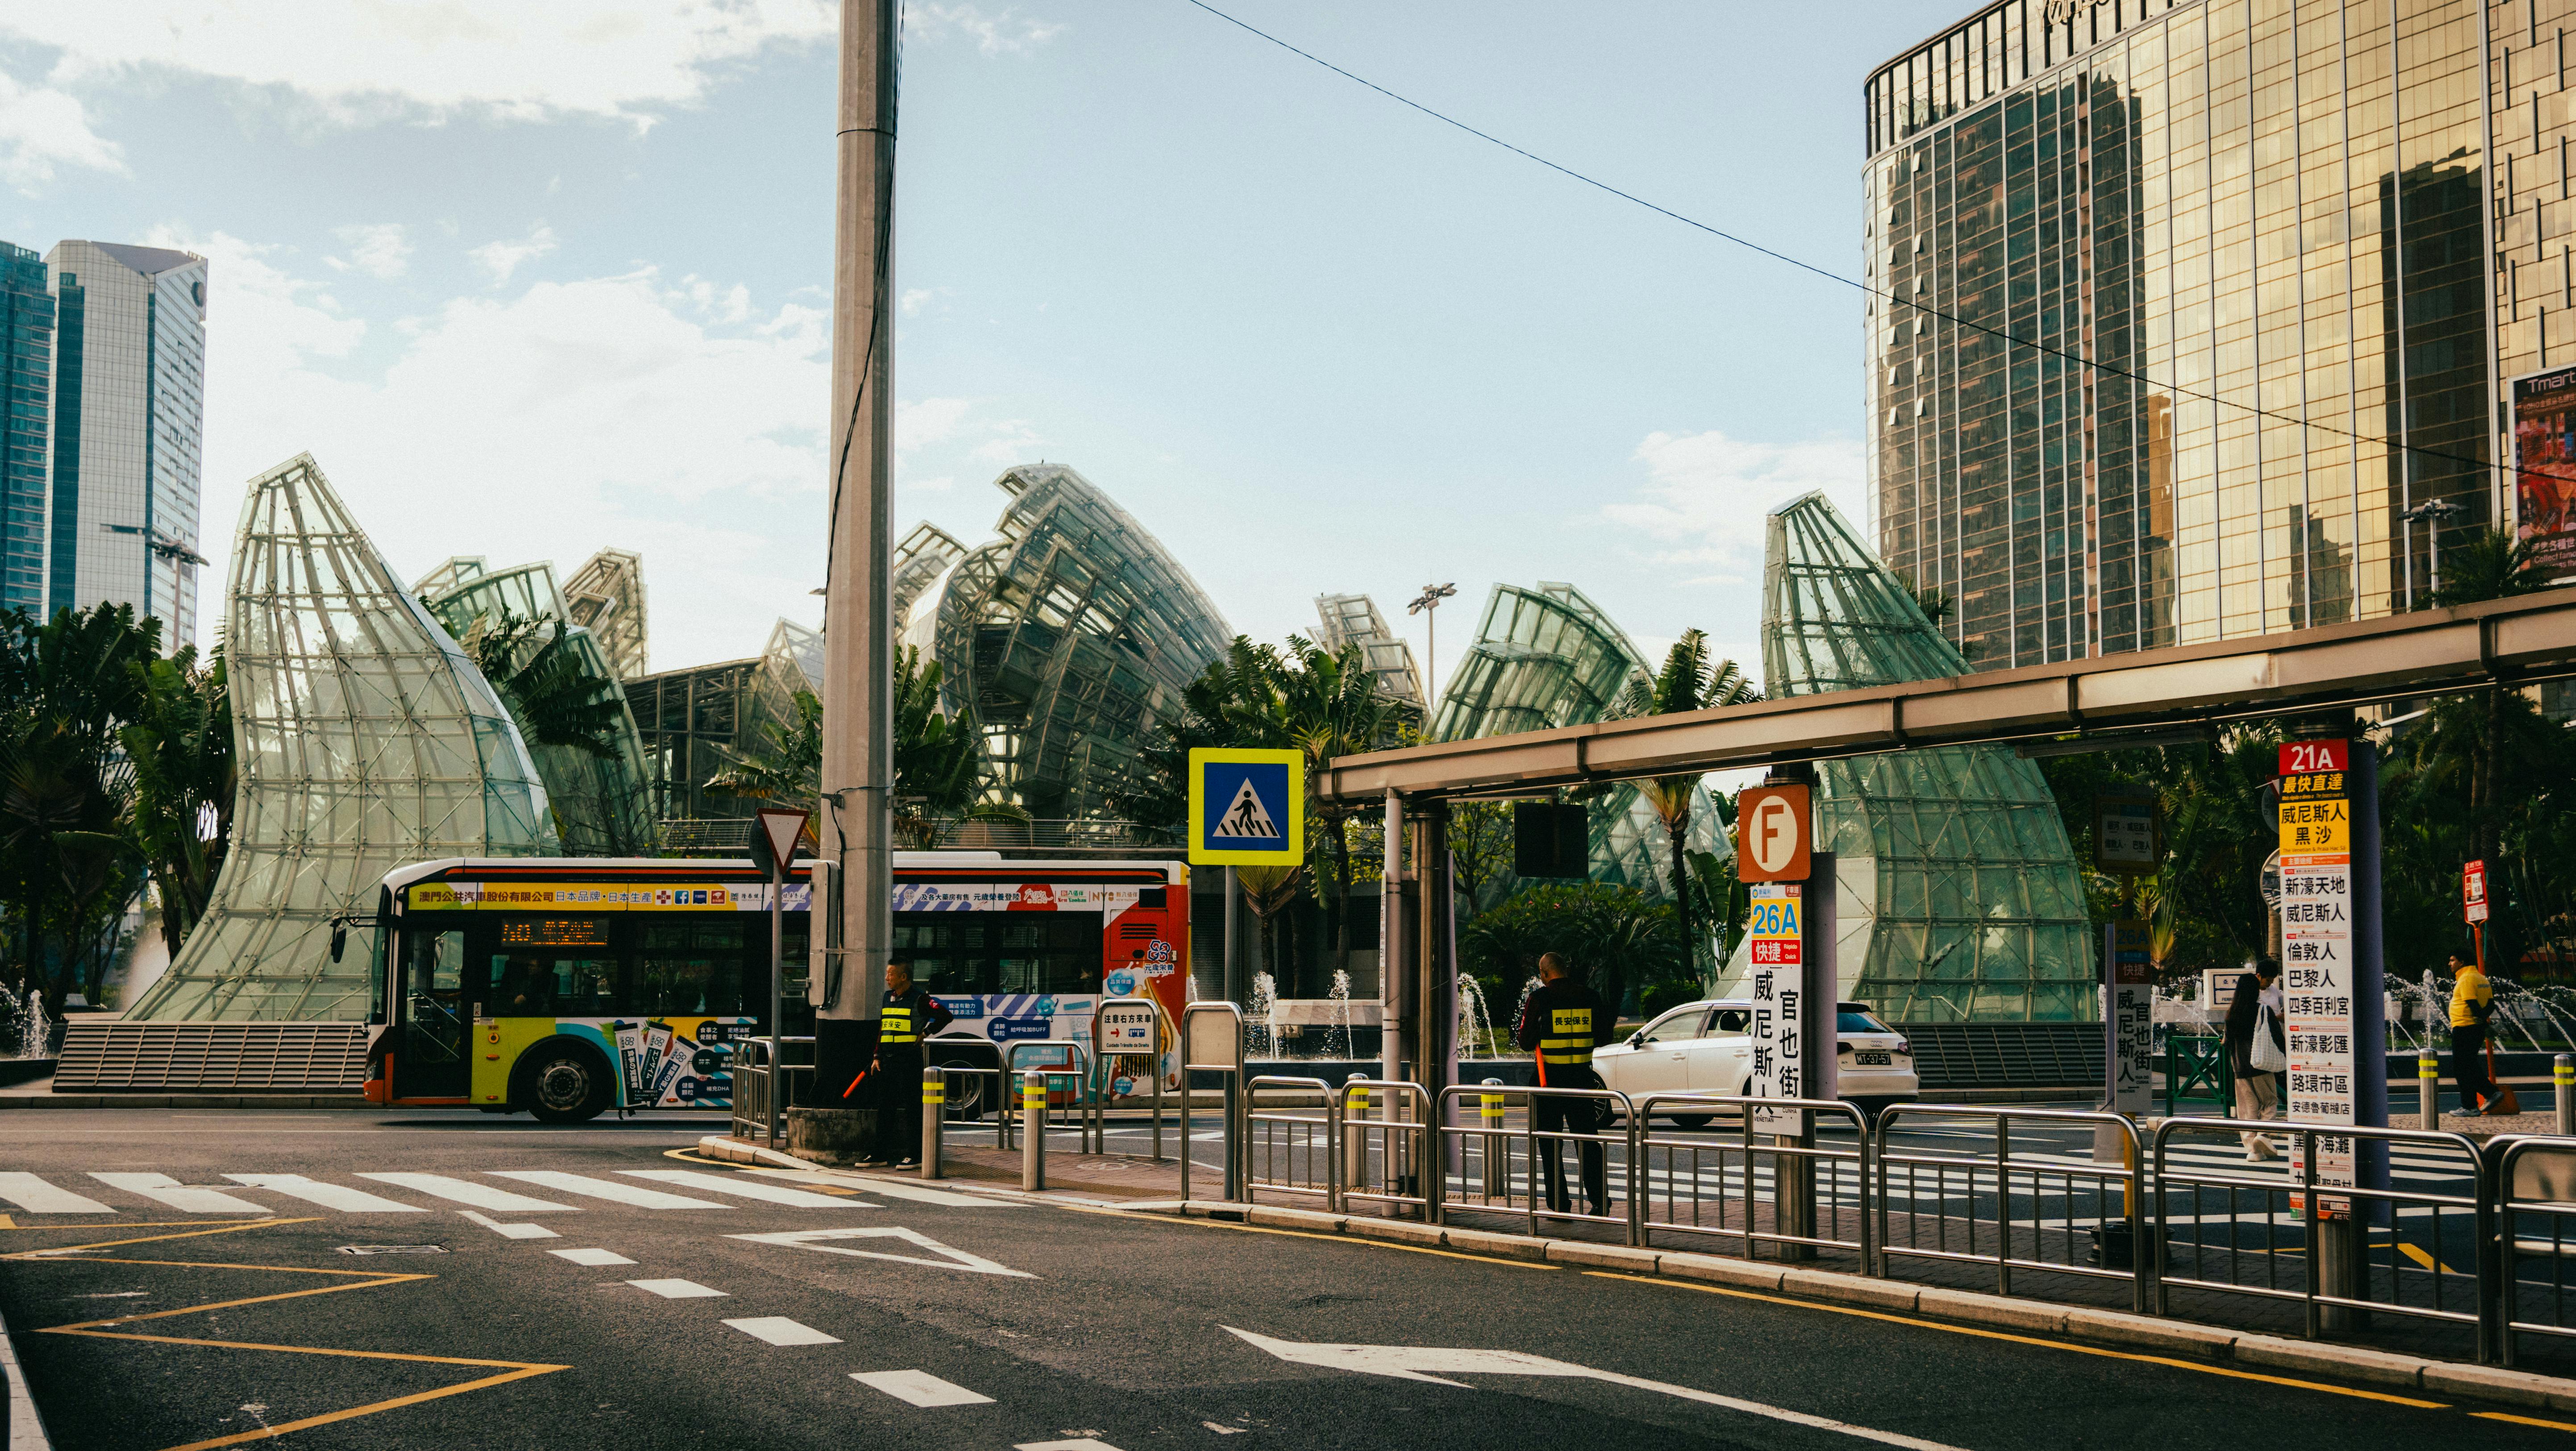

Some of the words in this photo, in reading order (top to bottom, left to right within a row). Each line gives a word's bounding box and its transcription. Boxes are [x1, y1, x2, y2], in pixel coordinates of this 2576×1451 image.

[2534, 553, 2558, 563] Collect
[2291, 745, 2334, 770] 21A
[2283, 773, 2343, 793] 最快直達
[2282, 803, 2346, 823] 威尼斯人
[1762, 805, 1784, 863] F
[2285, 876, 2345, 895] 新濠天地
[419, 892, 553, 902] 澳門公共汽車股份有限公司
[1753, 904, 1798, 934] 26A
[2286, 903, 2345, 922] 威尼斯人
[1756, 942, 1781, 961] 快捷
[2287, 942, 2336, 961] 倫敦人
[2123, 964, 2145, 976] 快捷
[2289, 969, 2335, 987] 巴黎人
[2289, 997, 2349, 1015] 四季百利宮
[882, 1021, 901, 1029] 安保安
[1105, 1014, 1151, 1023] 注意右方來車
[1555, 1016, 1589, 1026] 長安保安
[1754, 970, 1774, 1116] 威尼斯人
[1779, 989, 1799, 1098] 官也街
[2117, 990, 2135, 1082] 威尼斯人
[2134, 1002, 2151, 1071] 官也街
[2290, 1035, 2348, 1053] 新濠影匯
[1857, 1054, 1890, 1064] MT-37-57
[2292, 1074, 2348, 1093] 路環市區
[2292, 1101, 2350, 1114] 安德魯葡撻店
[2294, 1134, 2349, 1154] 黑海灘
